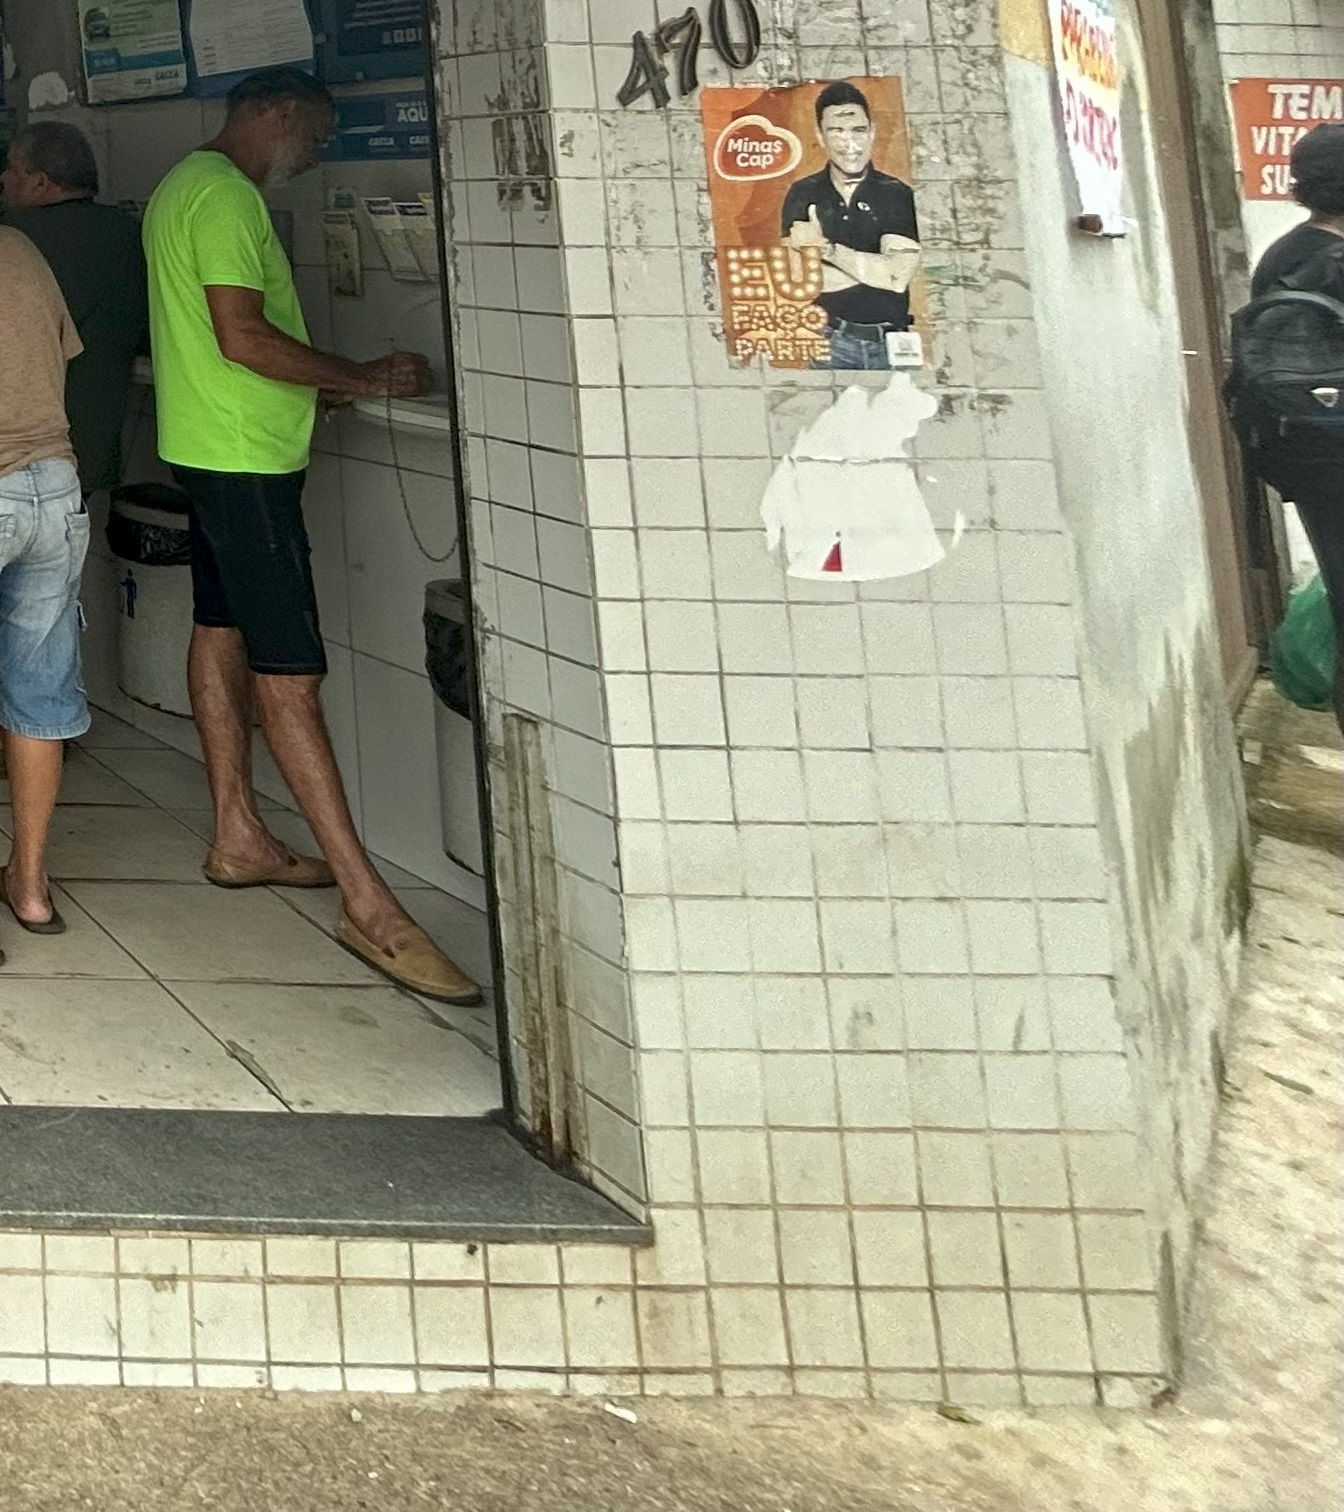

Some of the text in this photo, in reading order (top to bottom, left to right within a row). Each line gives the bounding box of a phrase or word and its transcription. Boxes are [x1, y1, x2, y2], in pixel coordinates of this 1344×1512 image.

[1266, 83, 1344, 121] TEM
[726, 137, 783, 154] Minas
[735, 153, 775, 170] Cap
[725, 245, 823, 302] EU
[730, 303, 830, 339] FAÇO
[734, 338, 833, 362] PARTE
